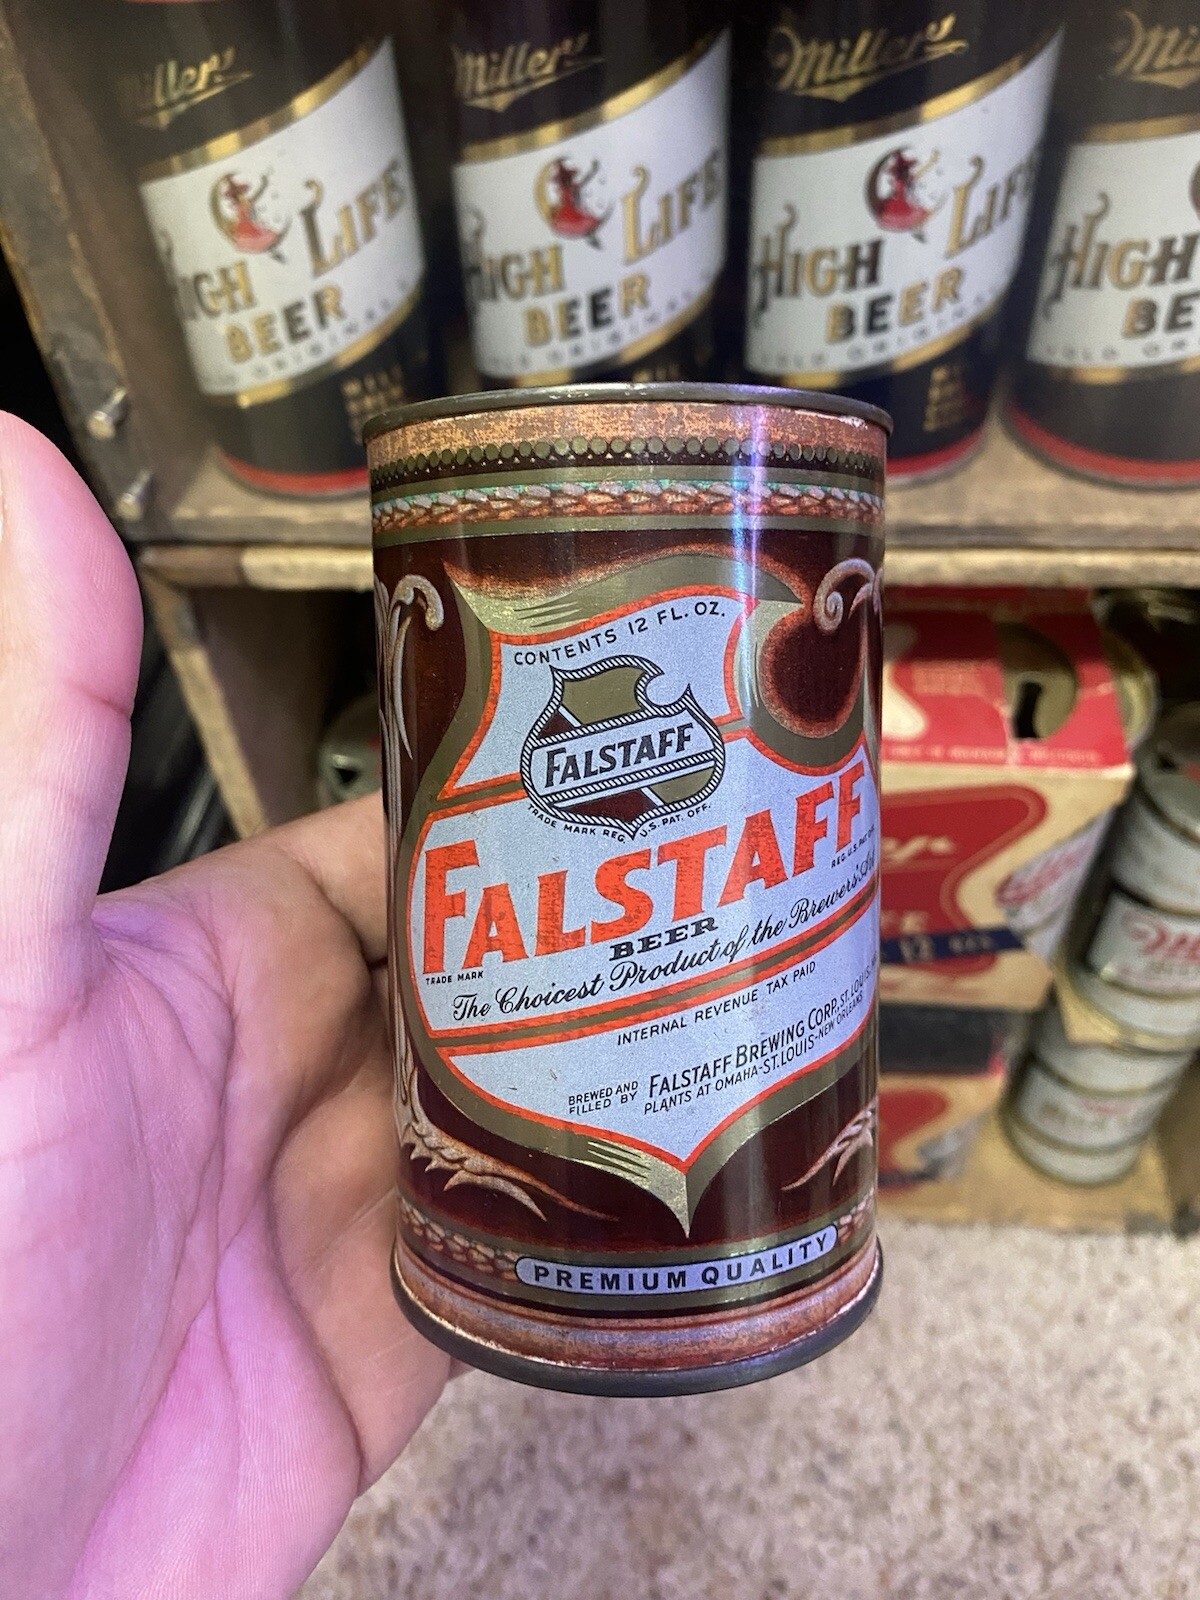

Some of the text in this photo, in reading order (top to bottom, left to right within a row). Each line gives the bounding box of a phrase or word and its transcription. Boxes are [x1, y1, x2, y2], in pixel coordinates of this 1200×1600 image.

[752, 202, 885, 328] HIGH
[225, 284, 345, 365] BEER
[522, 272, 649, 348] BEER
[825, 266, 966, 345] BEER
[514, 601, 726, 666] CONTENTS 12 FL. OZ.
[544, 723, 693, 789] FALSTAFF
[527, 803, 711, 844] TRADE MARK REG. U.S. PAT. OFF.
[423, 762, 866, 974] FALSTAFF
[453, 993, 491, 1021] The
[495, 974, 604, 1014] Choicest
[609, 939, 722, 992] Product
[719, 925, 748, 963] of
[748, 914, 787, 947] the
[609, 917, 718, 961] BEER
[425, 970, 484, 985] TRADE MARK
[617, 961, 816, 1045] INTERNAL REVENUE TAX PAID
[649, 1055, 732, 1098] FALSTAFF
[735, 1020, 805, 1068] BREWING
[568, 1081, 638, 1106] BREWED AND
[569, 1091, 638, 1116] FILLED BY
[644, 1090, 691, 1115] PLANTS
[697, 1082, 711, 1098] AT
[533, 1232, 828, 1291] PREMIUM QUALITY
